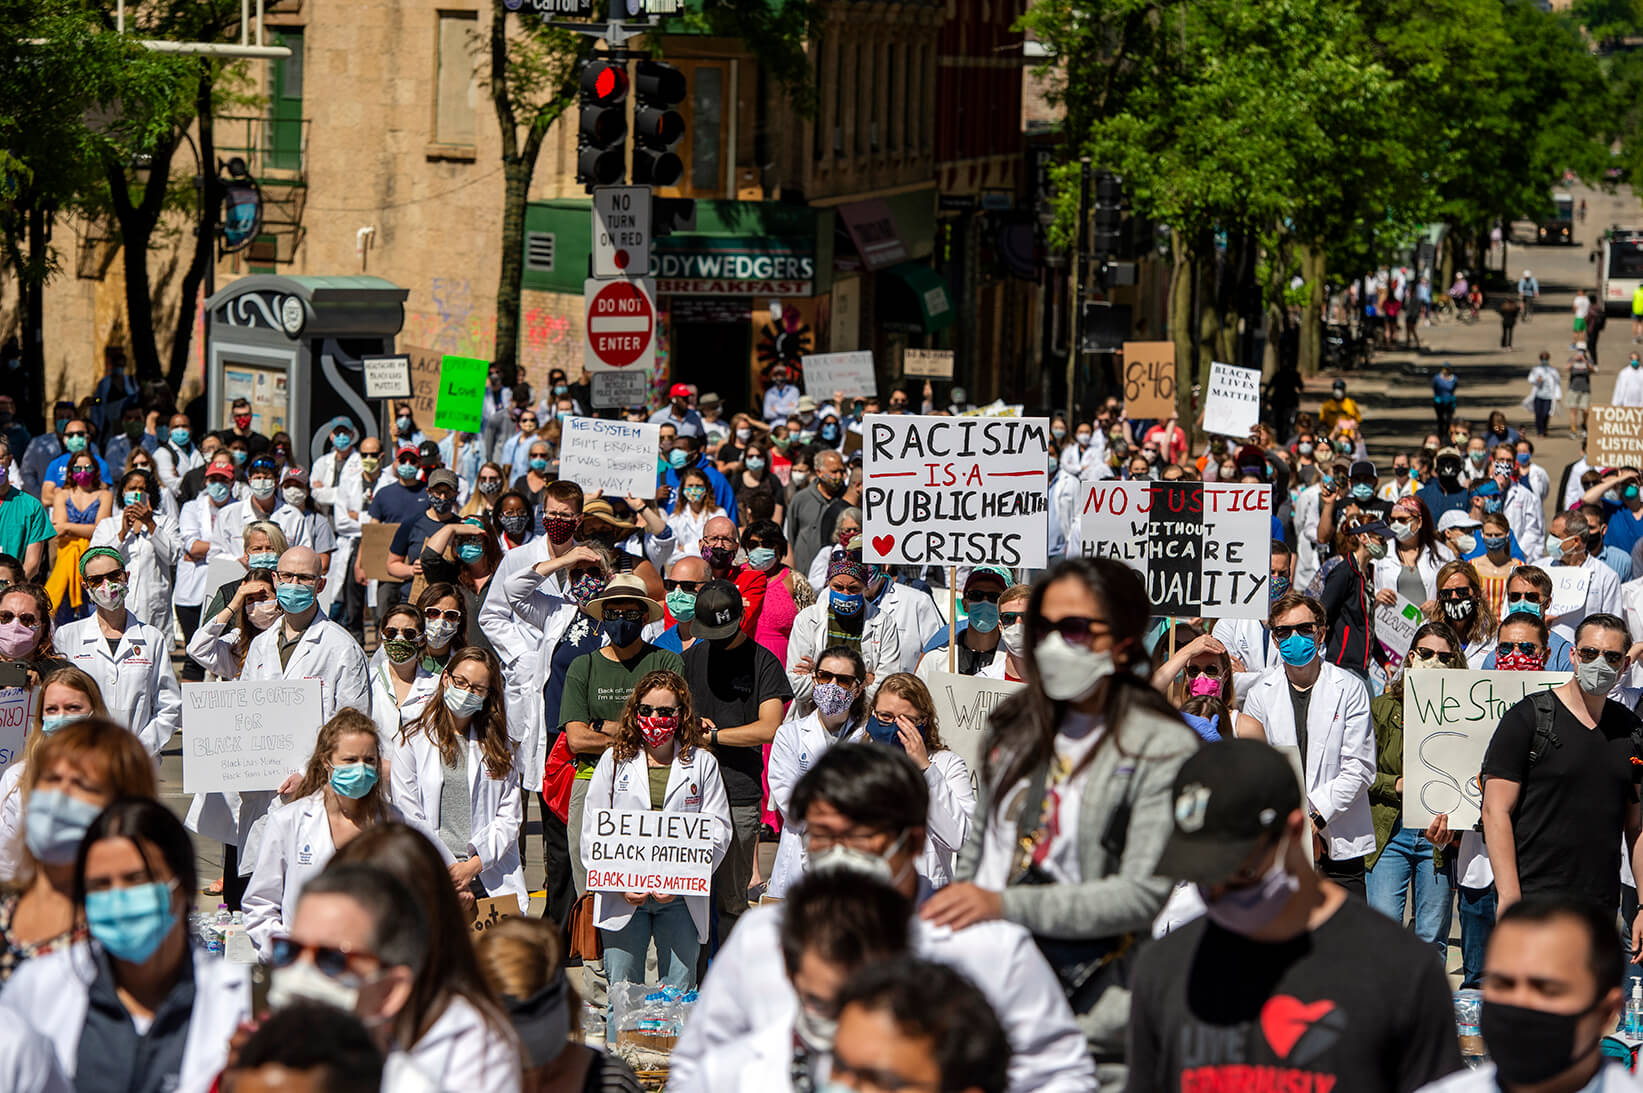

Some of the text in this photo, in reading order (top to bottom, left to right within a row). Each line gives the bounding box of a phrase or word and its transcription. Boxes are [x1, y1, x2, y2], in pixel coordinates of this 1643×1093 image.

[612, 194, 630, 211] NO
[608, 215, 635, 228] TURN
[600, 232, 642, 247] ON RED
[656, 280, 808, 293] BREAKFAST
[598, 298, 642, 312] DO NOT
[599, 337, 640, 351] ENTER
[1125, 361, 1174, 402] 8:46
[1215, 366, 1253, 380] BLACK
[1220, 378, 1255, 389] LIVES
[1212, 388, 1258, 403] MATTER
[1592, 406, 1643, 423] TODAY
[570, 418, 641, 438] THE SYSTEM
[872, 422, 1048, 462] RACISIM
[565, 455, 654, 472] IT WAS DESIGNED
[571, 473, 593, 487] THIS
[924, 463, 983, 486] IS A
[866, 487, 1049, 526] PUBLIC HEALTH
[1083, 486, 1270, 515] NO JUSTICE
[1131, 521, 1216, 536] WITHOUT
[901, 531, 1022, 566] CRISIS
[1082, 540, 1244, 563] HEALTHCARE
[1136, 569, 1267, 606] UALITY
[190, 687, 305, 710] WHITE COATS
[1409, 676, 1460, 726] We
[234, 713, 263, 731] FOR
[192, 734, 295, 758] BLACK LIVES
[220, 759, 240, 769] Black
[597, 811, 711, 840] BELIEVE
[592, 841, 713, 864] BLACK PATIENTS
[588, 869, 708, 892] BLACK LIVES MATTER
